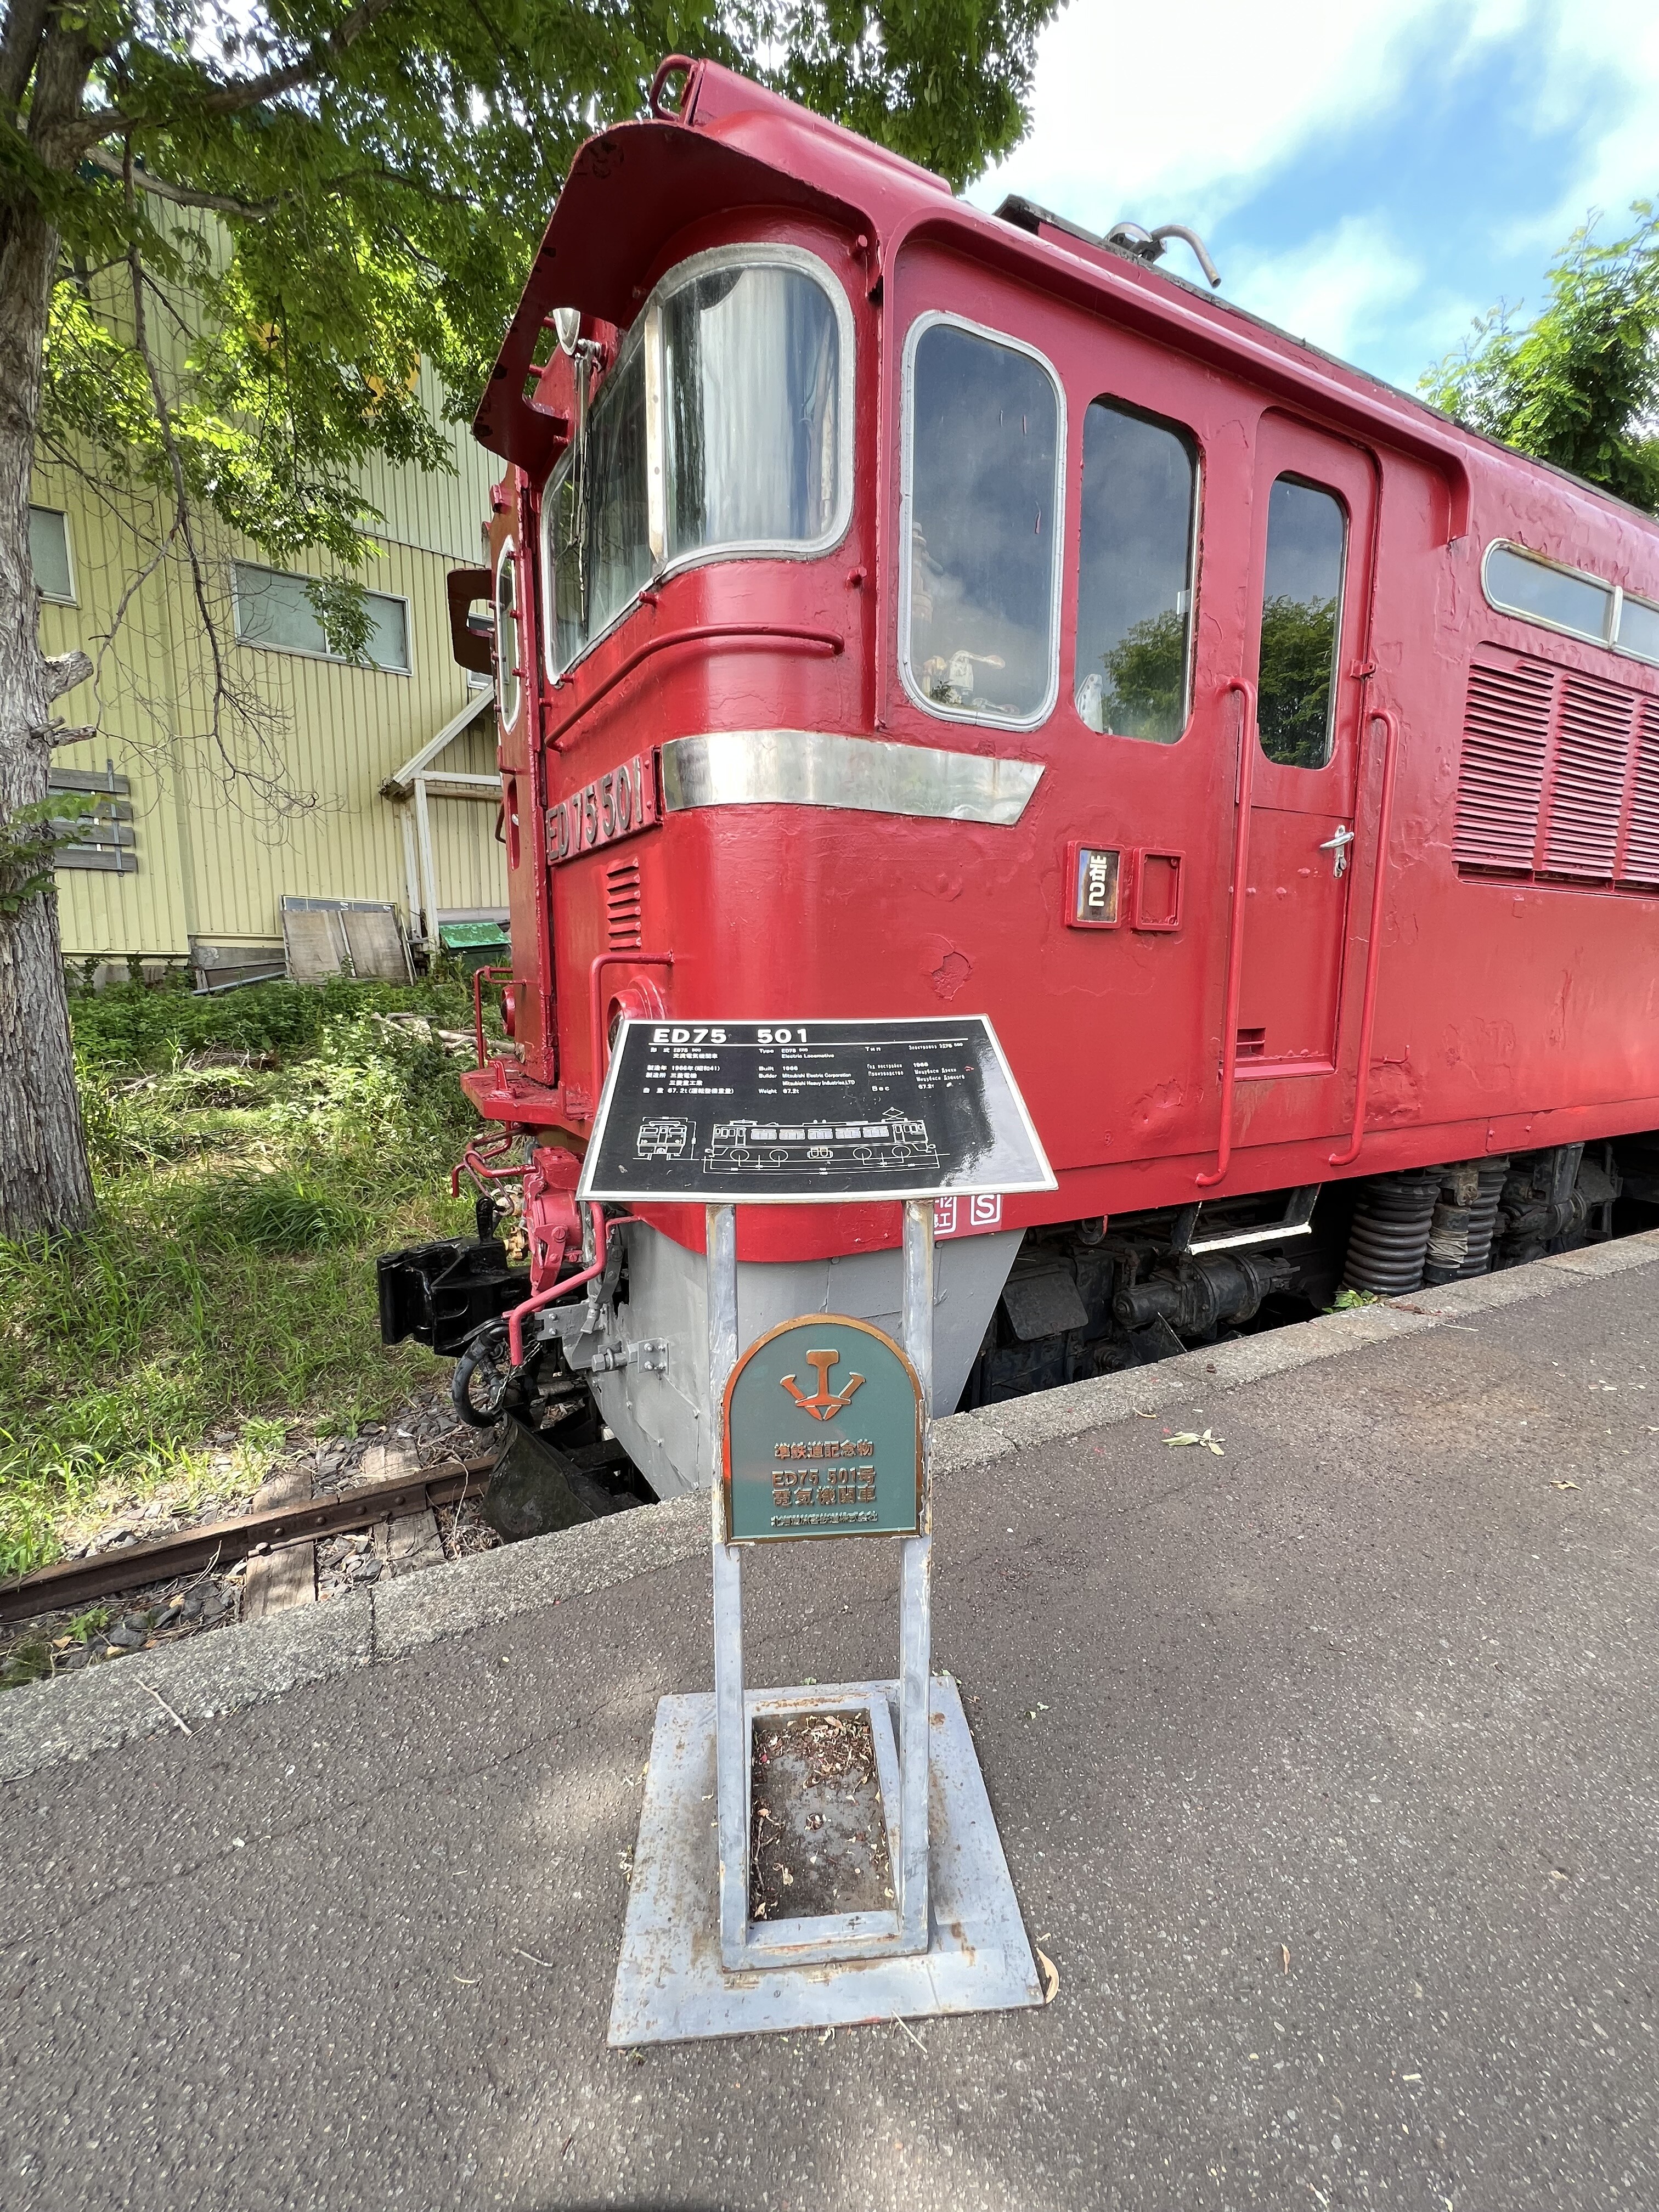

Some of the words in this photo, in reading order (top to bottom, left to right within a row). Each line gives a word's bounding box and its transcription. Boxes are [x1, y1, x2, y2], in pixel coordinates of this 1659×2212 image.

[653, 1028, 727, 1043] ED75
[757, 1028, 808, 1043] 501
[975, 1194, 995, 1218] S
[774, 1438, 873, 1460] 準鉄道記念物
[772, 1468, 820, 1487] ED75
[827, 1465, 876, 1485] 501号
[772, 1483, 877, 1507] 電気機関車
